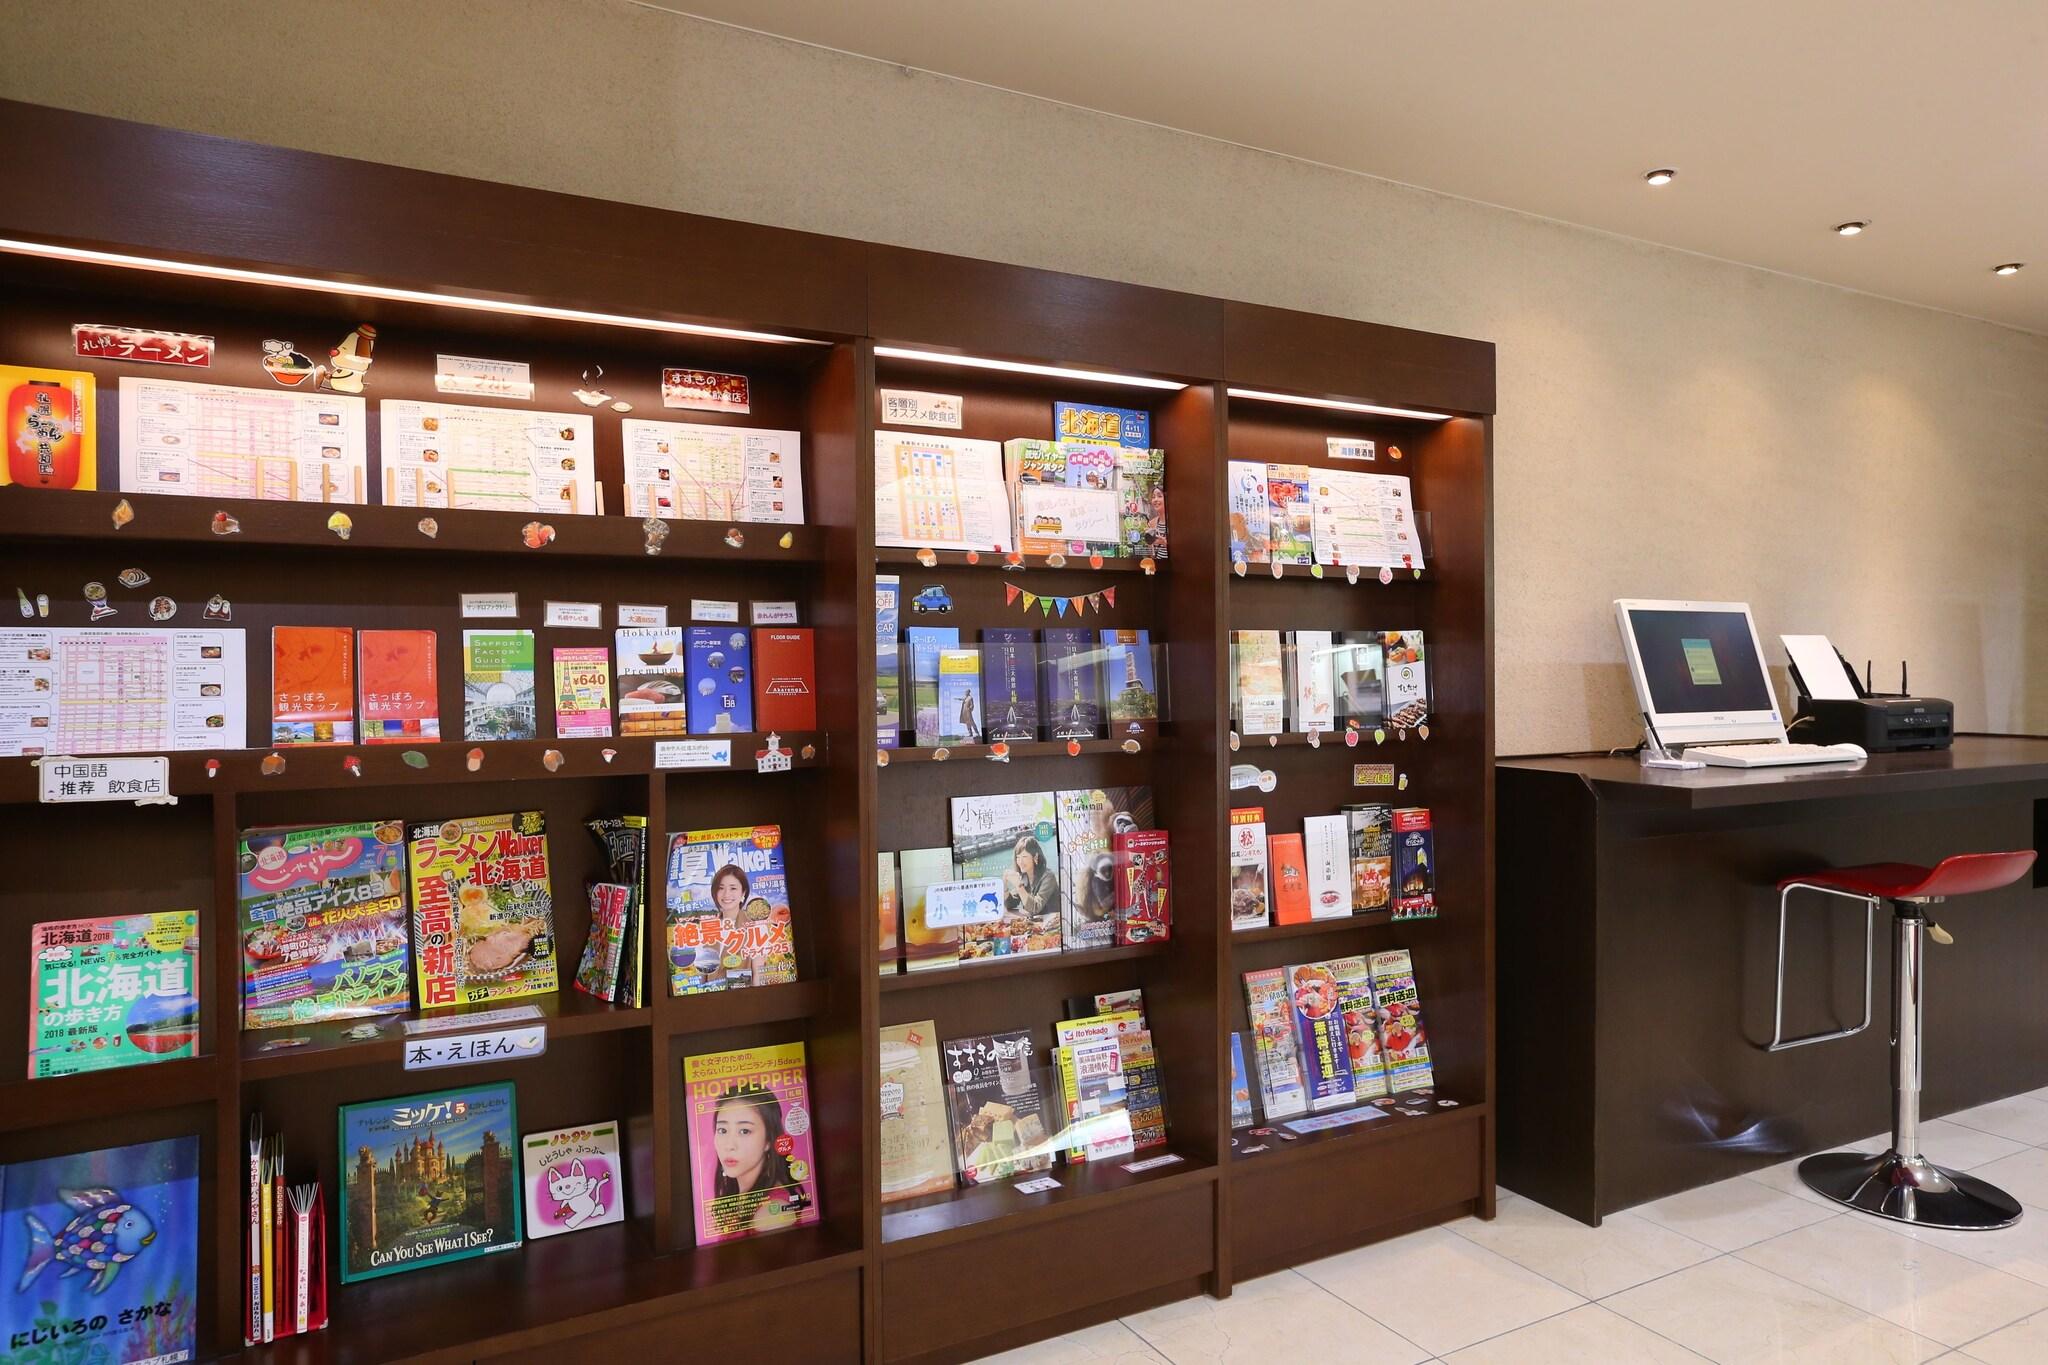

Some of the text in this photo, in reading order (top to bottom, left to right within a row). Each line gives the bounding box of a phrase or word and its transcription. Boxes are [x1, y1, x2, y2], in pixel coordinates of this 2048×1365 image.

[672, 373, 717, 386] すすきの
[1060, 407, 1121, 440] 北海道
[622, 628, 677, 637] Hokkaido
[876, 623, 894, 633] CAR
[573, 673, 606, 686] ¥640
[624, 668, 679, 677] Premium
[278, 691, 327, 703] さっぽろ
[368, 691, 413, 702] さっぽろ
[278, 702, 339, 712] 観光マップ
[368, 701, 426, 711] 観光マップ
[54, 763, 108, 779] 中国語
[107, 778, 161, 794] 飲食店
[959, 801, 995, 831] 小樽
[468, 855, 547, 886] 北海道
[322, 896, 402, 924] 花火大会50
[40, 929, 93, 946] 北海道
[416, 874, 457, 1005] 至高の新店
[80, 956, 106, 966] NEWS
[44, 957, 189, 1009] 北海道
[333, 959, 404, 992] パノラマ
[1379, 987, 1417, 1006] 無料送迎
[43, 1004, 123, 1028] の歩き方
[44, 1029, 64, 1039] 2018
[409, 1037, 515, 1064] 本・えほん
[693, 1068, 804, 1100] HOT PEPPER
[391, 1101, 452, 1126] ミッケ!
[550, 1130, 592, 1147] ノンタン
[10, 1301, 173, 1350] にじいろの さかな
